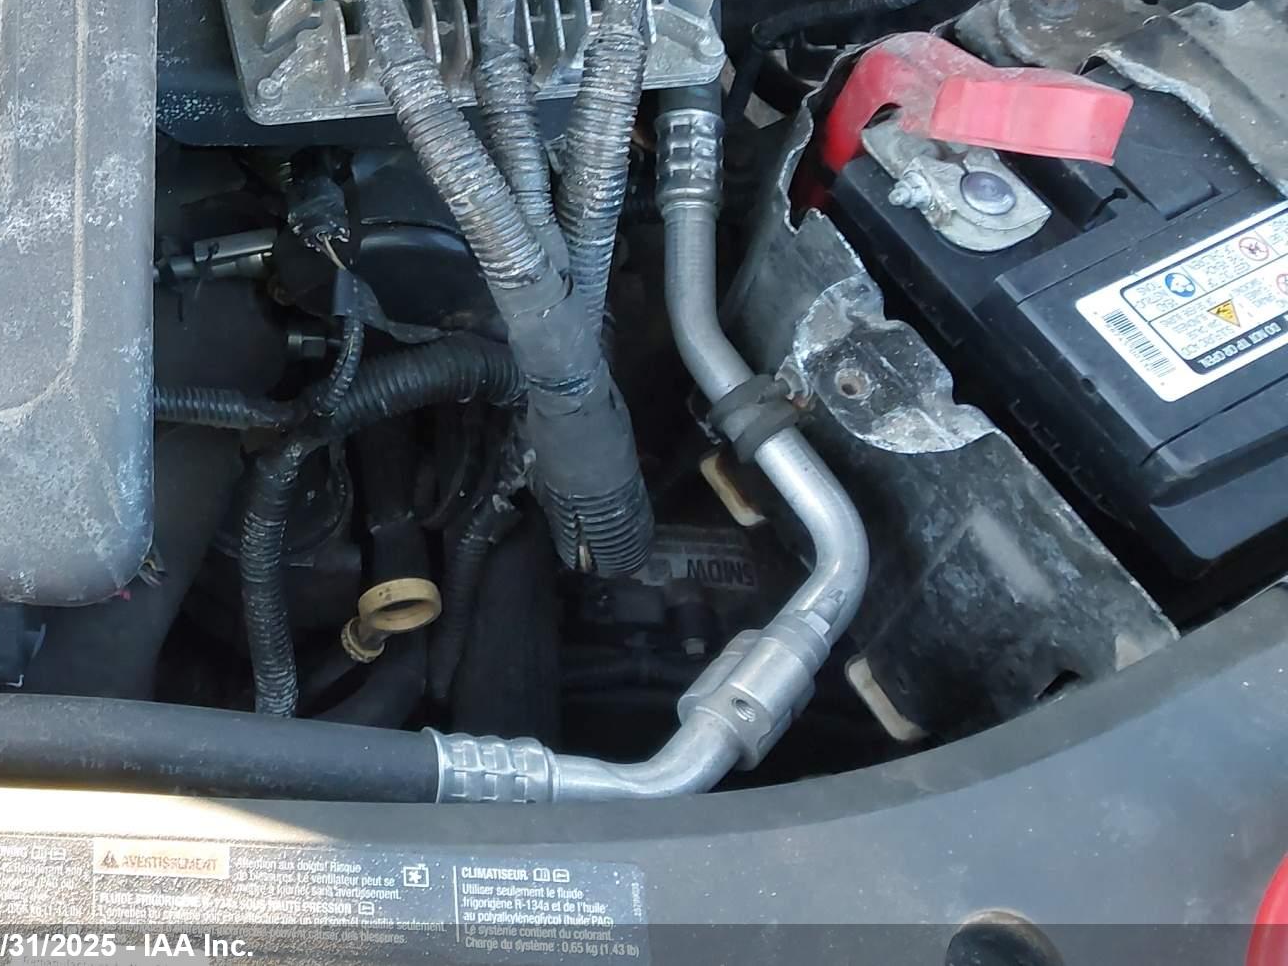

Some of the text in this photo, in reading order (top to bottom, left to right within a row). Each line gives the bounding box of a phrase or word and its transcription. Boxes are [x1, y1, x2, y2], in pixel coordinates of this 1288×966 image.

[122, 855, 217, 871] AVERTISSEMENT
[330, 861, 362, 874] Risque
[383, 878, 395, 887] se
[462, 883, 493, 895] Utiliser
[496, 885, 545, 898] seulement
[557, 887, 584, 900] fluide
[302, 901, 351, 914] PRESSION
[514, 898, 550, 912] R-134a
[563, 900, 576, 913] de
[463, 912, 476, 922] au
[464, 923, 476, 935] Le
[559, 928, 571, 940] du
[465, 936, 499, 951] Charge
[501, 938, 513, 950] du
[585, 942, 598, 957] kg
[626, 944, 640, 957] lb)
